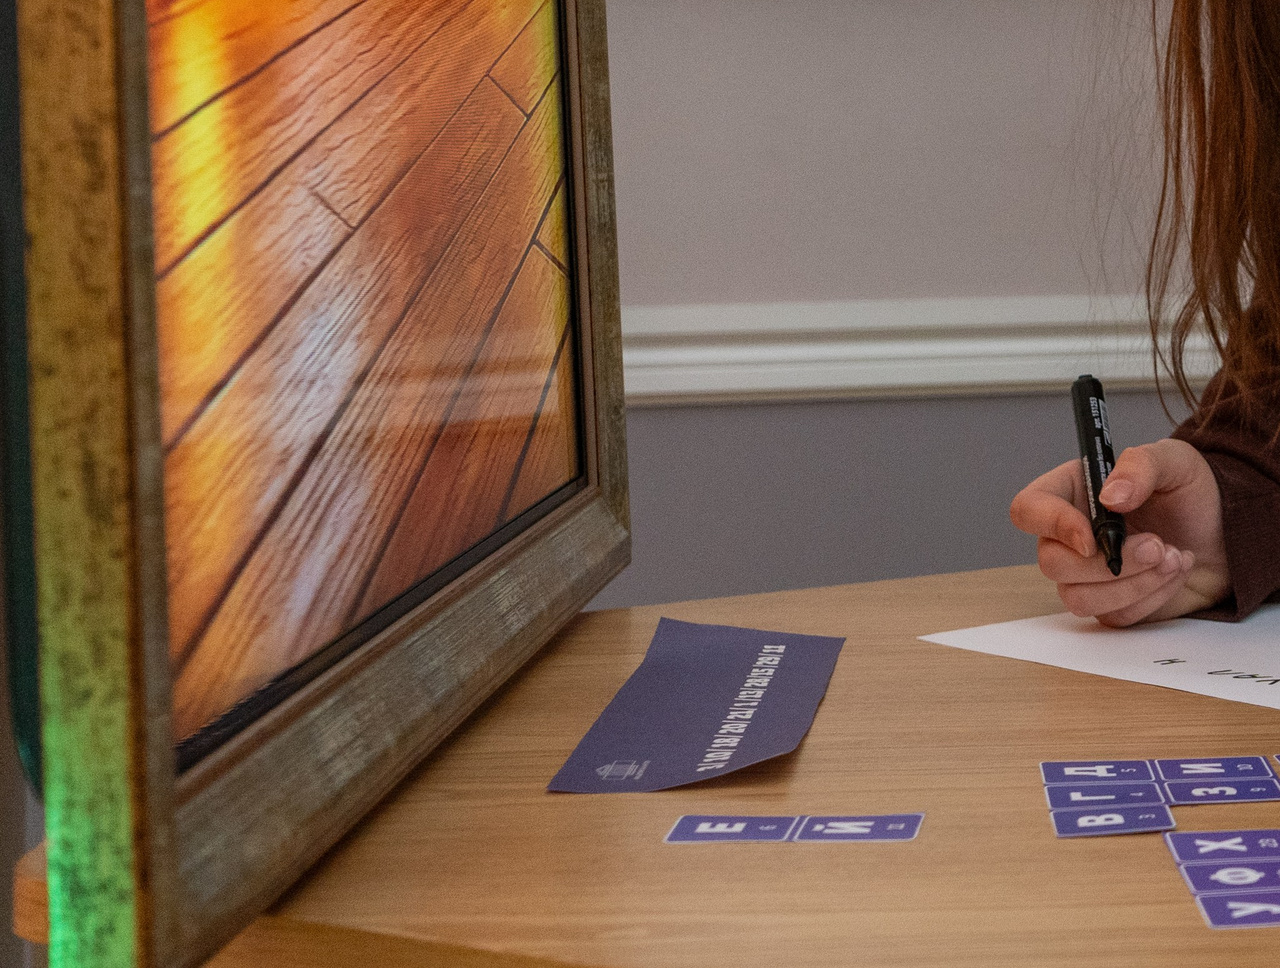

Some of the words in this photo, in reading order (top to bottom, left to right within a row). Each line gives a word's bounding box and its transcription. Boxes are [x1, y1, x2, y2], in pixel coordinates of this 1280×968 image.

[1063, 764, 1117, 778] Д
[1179, 762, 1226, 774] И
[1069, 791, 1116, 802] Г
[1076, 813, 1125, 828] В
[1194, 836, 1248, 854] Х
[1209, 867, 1265, 885] Ф
